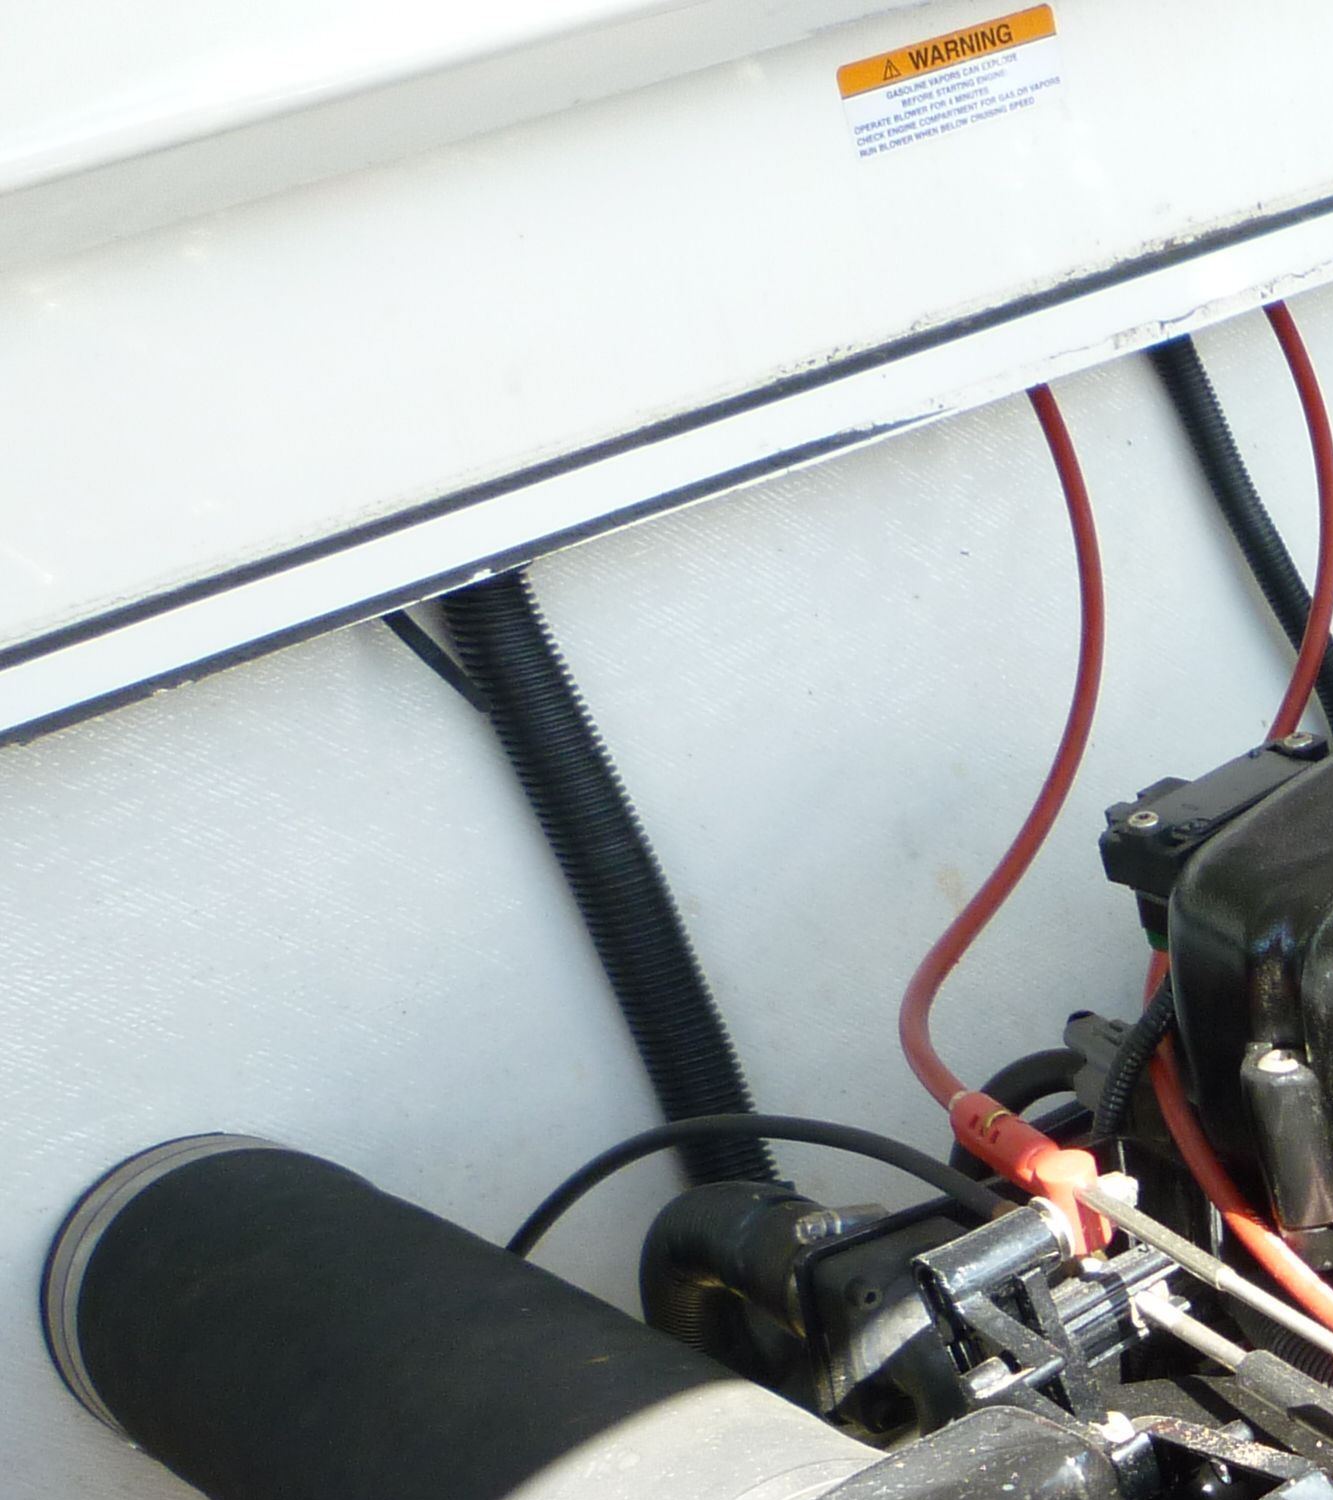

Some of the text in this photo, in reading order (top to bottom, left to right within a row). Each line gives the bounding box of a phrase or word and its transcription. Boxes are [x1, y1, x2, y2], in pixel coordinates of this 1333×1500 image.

[907, 23, 1013, 71] WARNING
[885, 82, 925, 99] GASOLINE
[928, 71, 960, 86] VAPORS
[961, 66, 978, 76] CAN
[901, 92, 933, 107] BEFORE
[935, 79, 974, 96] STARTING
[853, 117, 891, 134] OPERATE
[893, 106, 927, 122] BLOWER
[929, 101, 945, 111] FOR
[856, 130, 884, 145] CHECK
[886, 121, 915, 136] ENGINE
[918, 102, 978, 126] COMPARTMENT
[979, 97, 996, 108] FOR
[997, 91, 1014, 102] GAS
[1029, 77, 1060, 93] VAPORS
[878, 134, 912, 151] BLOWER
[914, 126, 938, 140] WHEN
[940, 118, 967, 132] BELOW
[1008, 97, 1034, 111] SPEED
